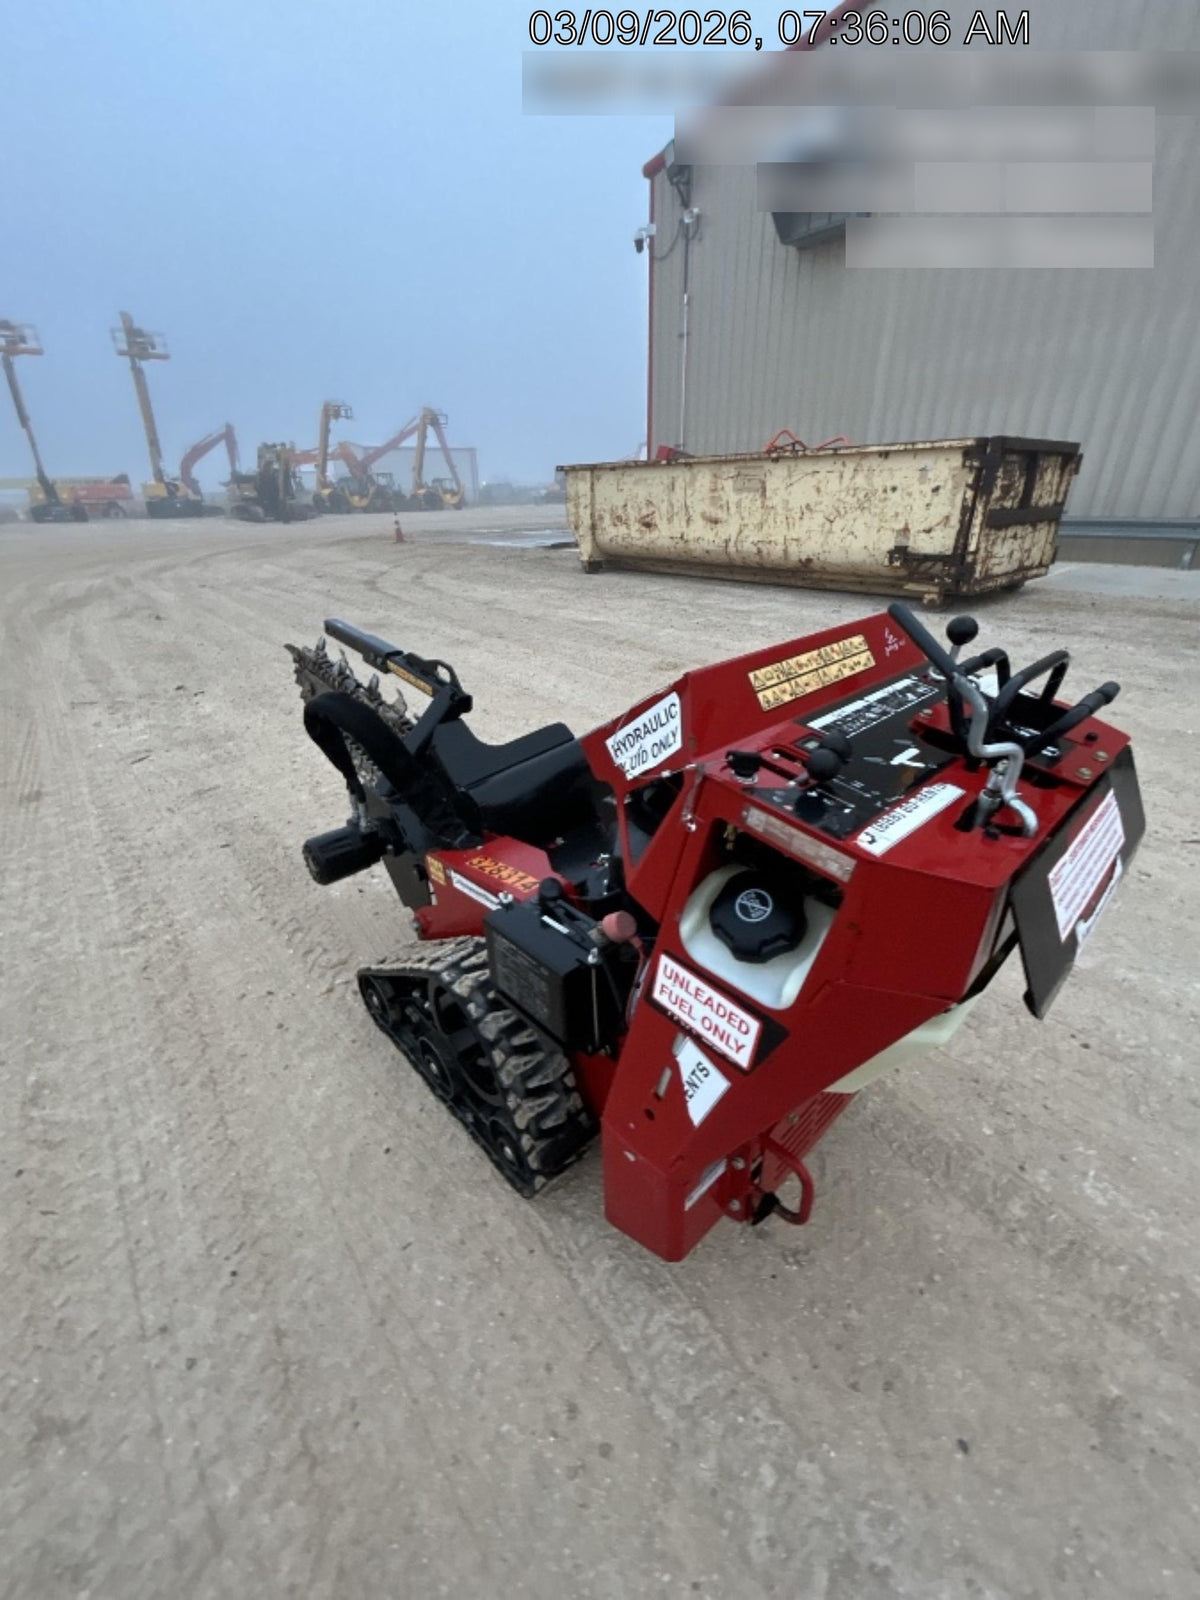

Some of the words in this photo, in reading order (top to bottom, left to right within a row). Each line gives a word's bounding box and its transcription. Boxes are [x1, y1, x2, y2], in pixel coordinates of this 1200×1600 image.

[611, 702, 678, 758] HYDRAULIC
[651, 726, 678, 758] ONLY
[659, 984, 697, 1022] FUEL
[701, 1016, 746, 1054] ONLY
[663, 964, 750, 1036] UNLEADED
